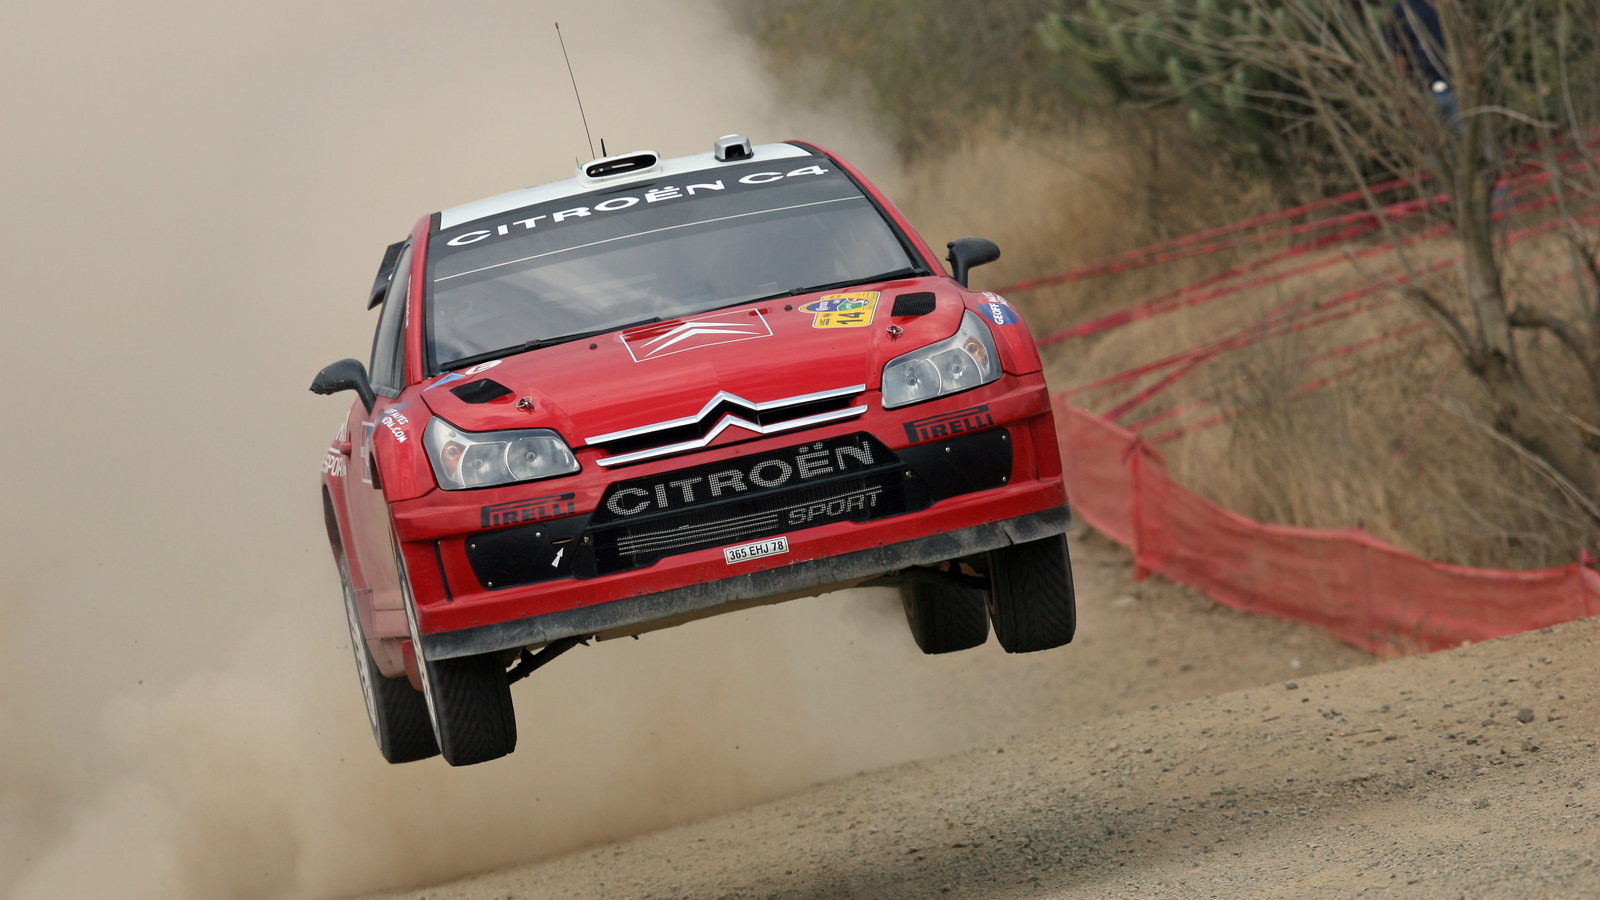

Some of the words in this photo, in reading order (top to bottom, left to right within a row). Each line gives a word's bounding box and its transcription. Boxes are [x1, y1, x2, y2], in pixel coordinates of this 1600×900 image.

[446, 179, 726, 246] CITROËN
[737, 164, 829, 185] C4
[836, 311, 865, 325] 14
[989, 303, 1004, 325] GEOFF
[903, 404, 995, 443] PIRELLI
[606, 440, 875, 516] CITROËN
[480, 491, 576, 528] PIRELLI
[788, 484, 883, 525] SPORT
[729, 547, 746, 561] 365
[749, 543, 769, 557] EHJ
[771, 540, 784, 553] 78
